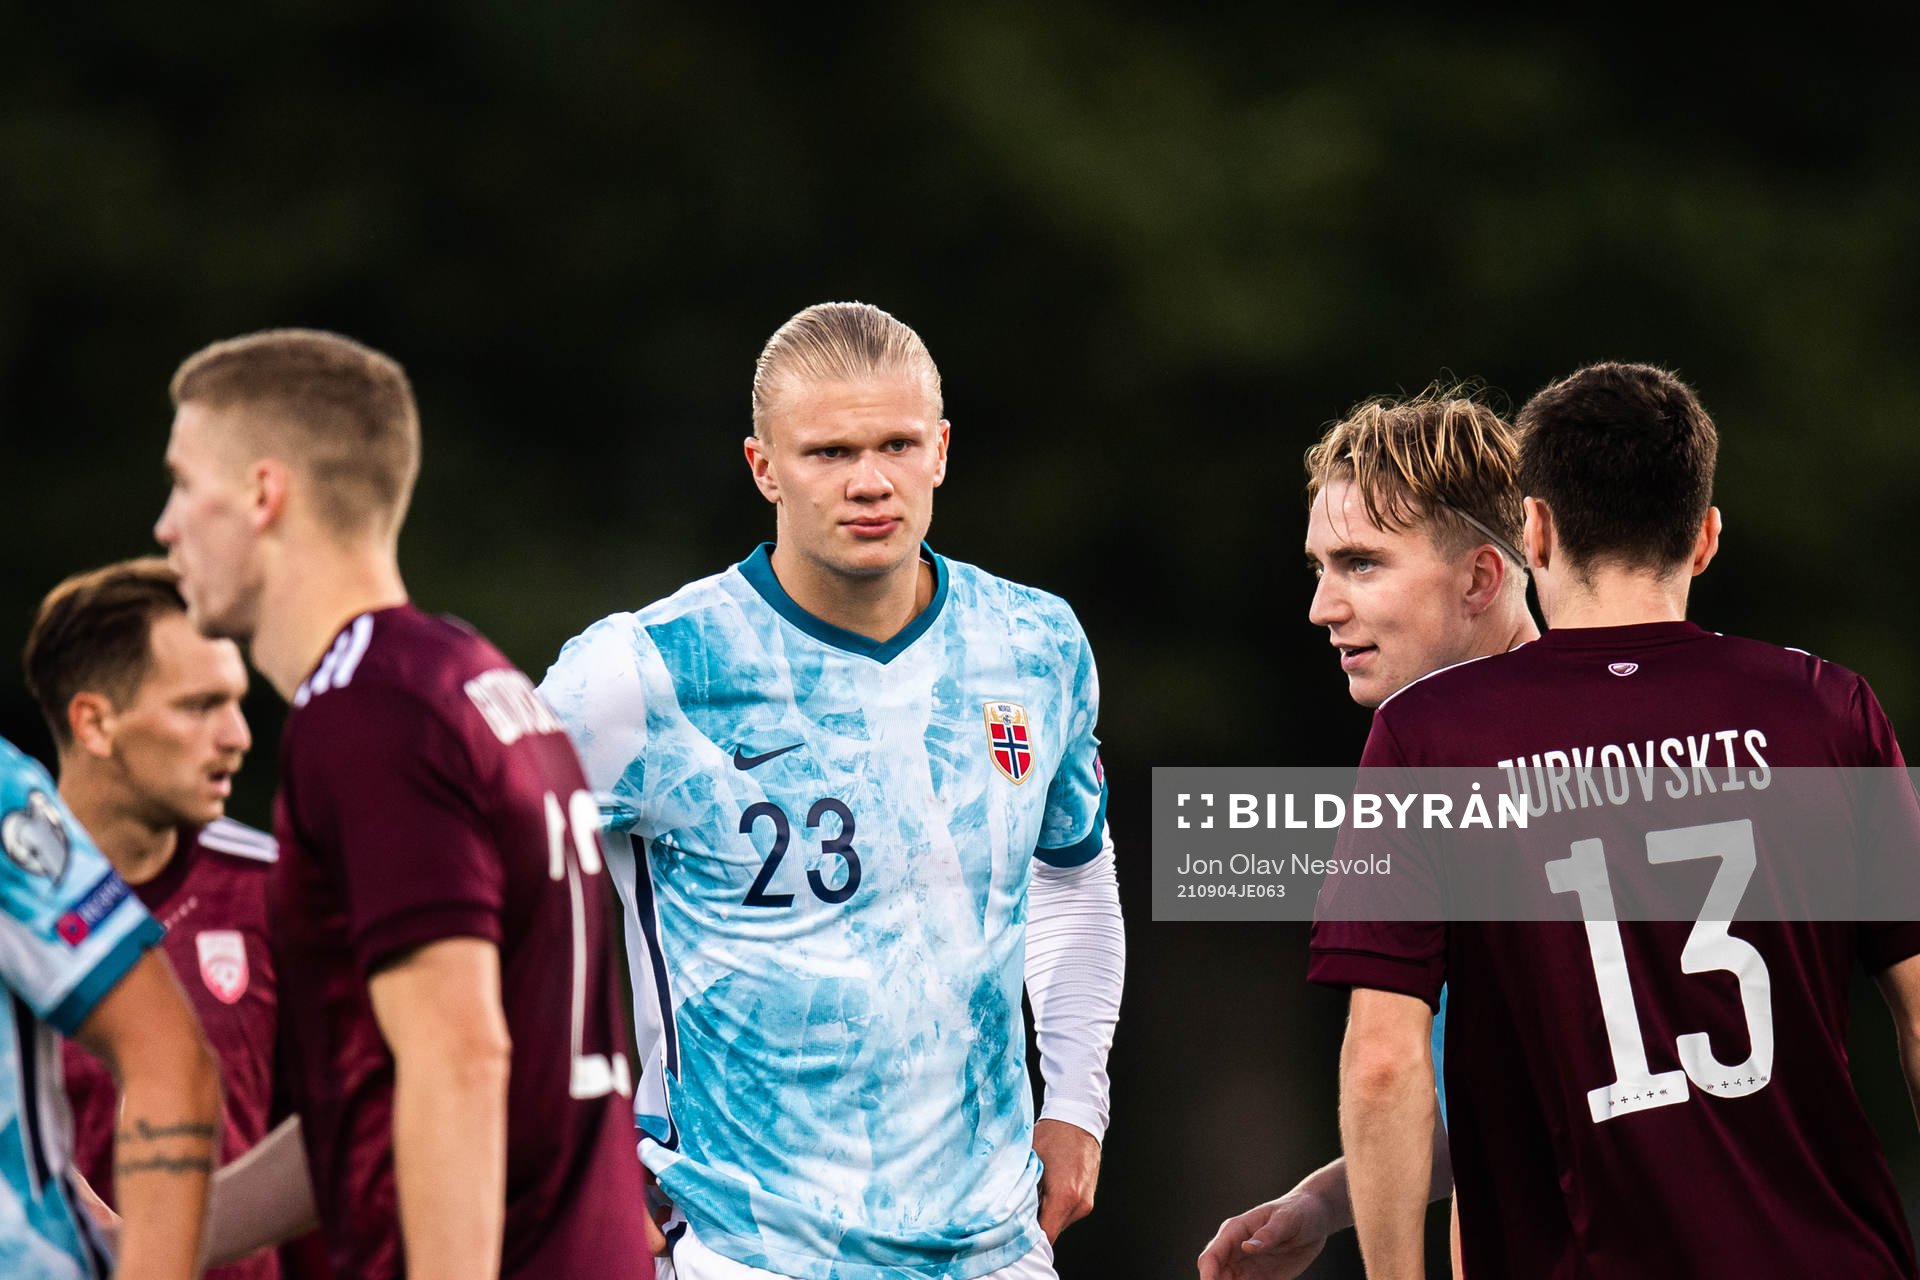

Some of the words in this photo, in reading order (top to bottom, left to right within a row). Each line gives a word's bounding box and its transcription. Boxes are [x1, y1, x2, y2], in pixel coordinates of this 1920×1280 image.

[1498, 729, 1772, 821] JURKOVSKIS
[739, 797, 861, 908] 23
[1545, 819, 1774, 1123] 13
